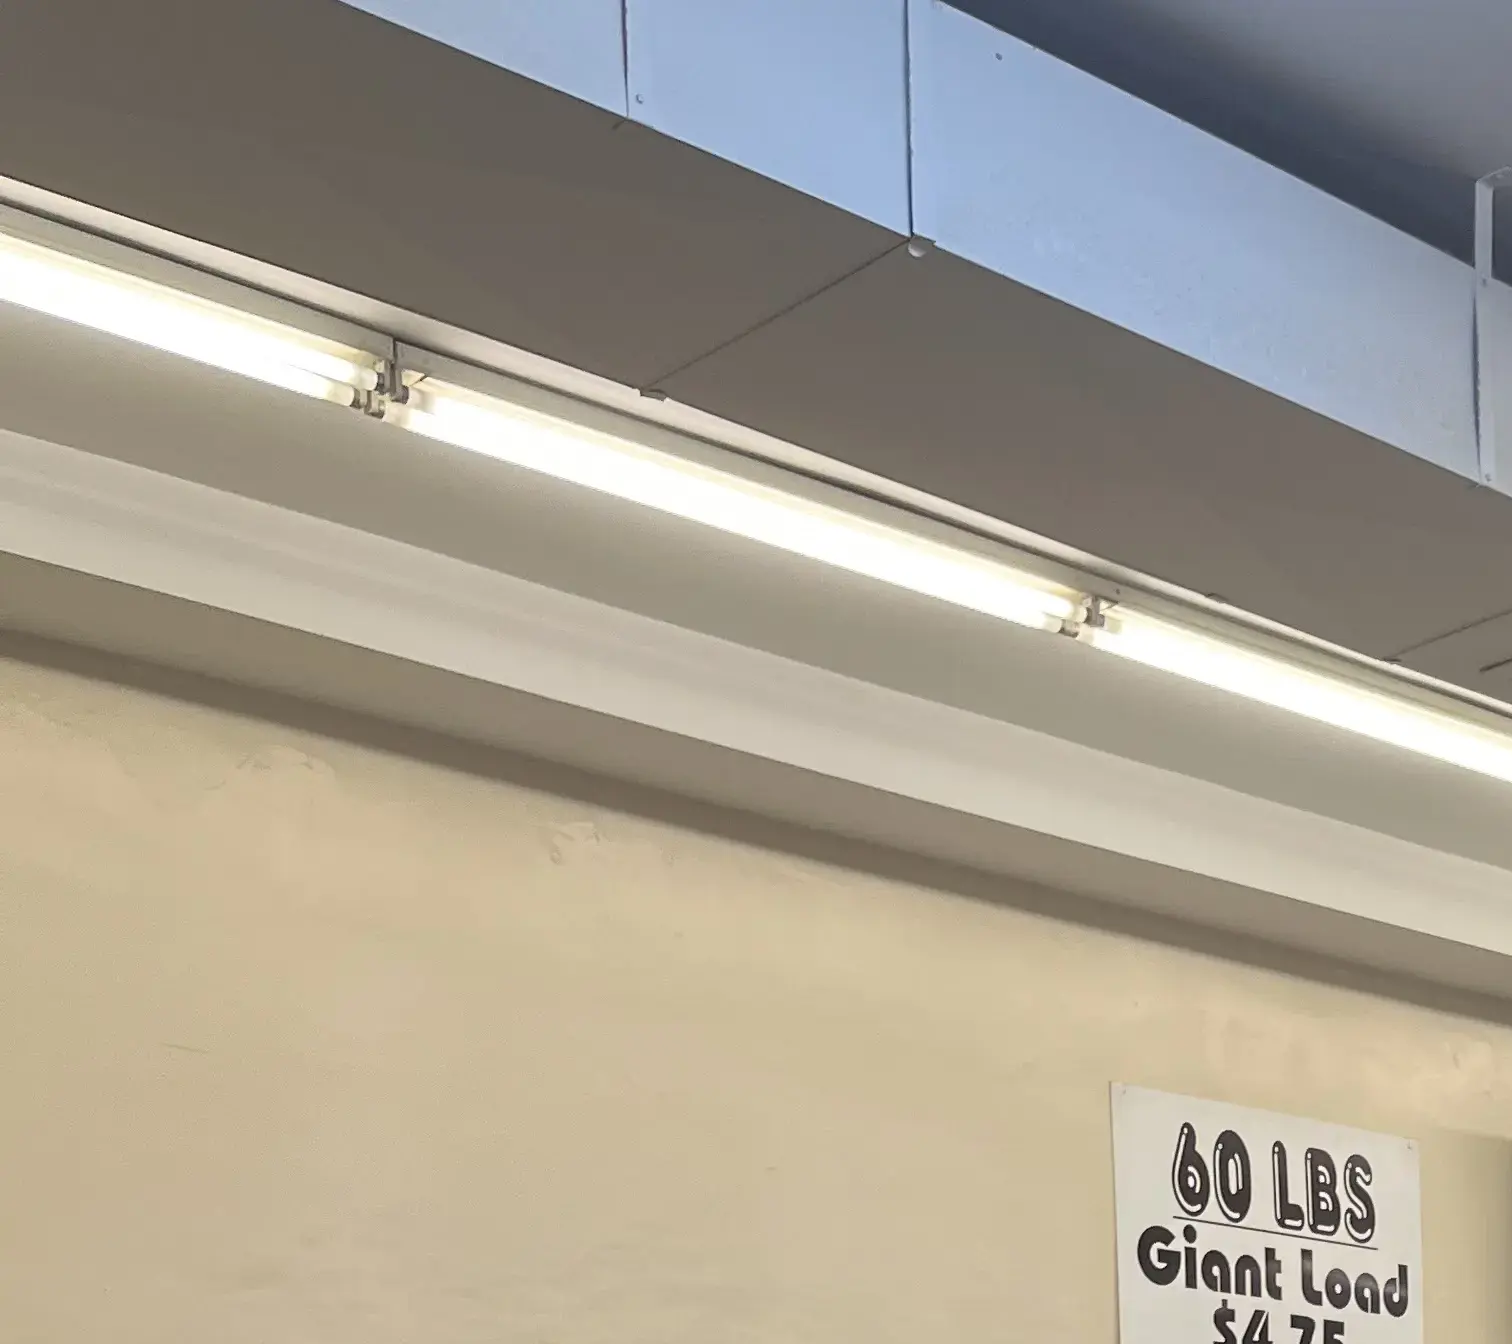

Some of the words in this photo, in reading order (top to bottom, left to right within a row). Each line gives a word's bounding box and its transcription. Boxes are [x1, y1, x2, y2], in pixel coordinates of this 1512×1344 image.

[1172, 1121, 1252, 1223] 60
[1272, 1140, 1376, 1244] LBS
[1137, 1224, 1283, 1301] Giant
[1300, 1247, 1409, 1318] Load
